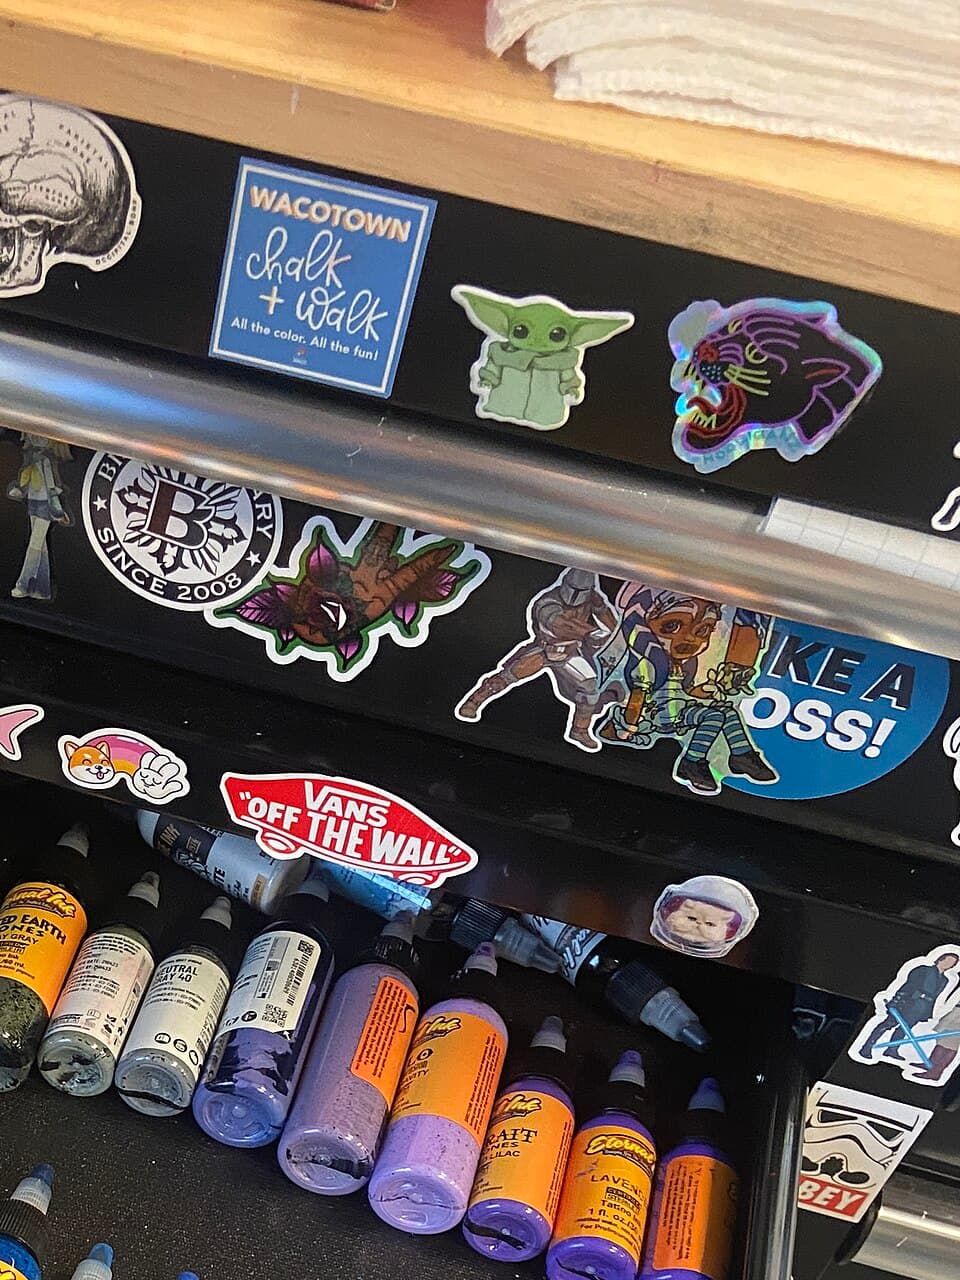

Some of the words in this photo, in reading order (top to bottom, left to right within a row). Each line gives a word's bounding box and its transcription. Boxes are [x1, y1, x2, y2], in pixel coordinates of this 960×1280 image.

[250, 185, 411, 243] WACOTOWN
[246, 226, 352, 289] chalk
[231, 317, 248, 329] All
[251, 322, 271, 336] the
[274, 328, 307, 345] color.
[310, 335, 328, 349] All
[331, 340, 351, 355] the
[354, 345, 379, 361] fun!
[97, 526, 168, 596] SINCE
[177, 572, 242, 600] 2008
[859, 662, 916, 711] A
[303, 780, 391, 827] VANS
[307, 811, 369, 859] THE
[13, 934, 40, 946] GRAY
[21, 914, 68, 945] EARTH
[177, 973, 193, 984] 40
